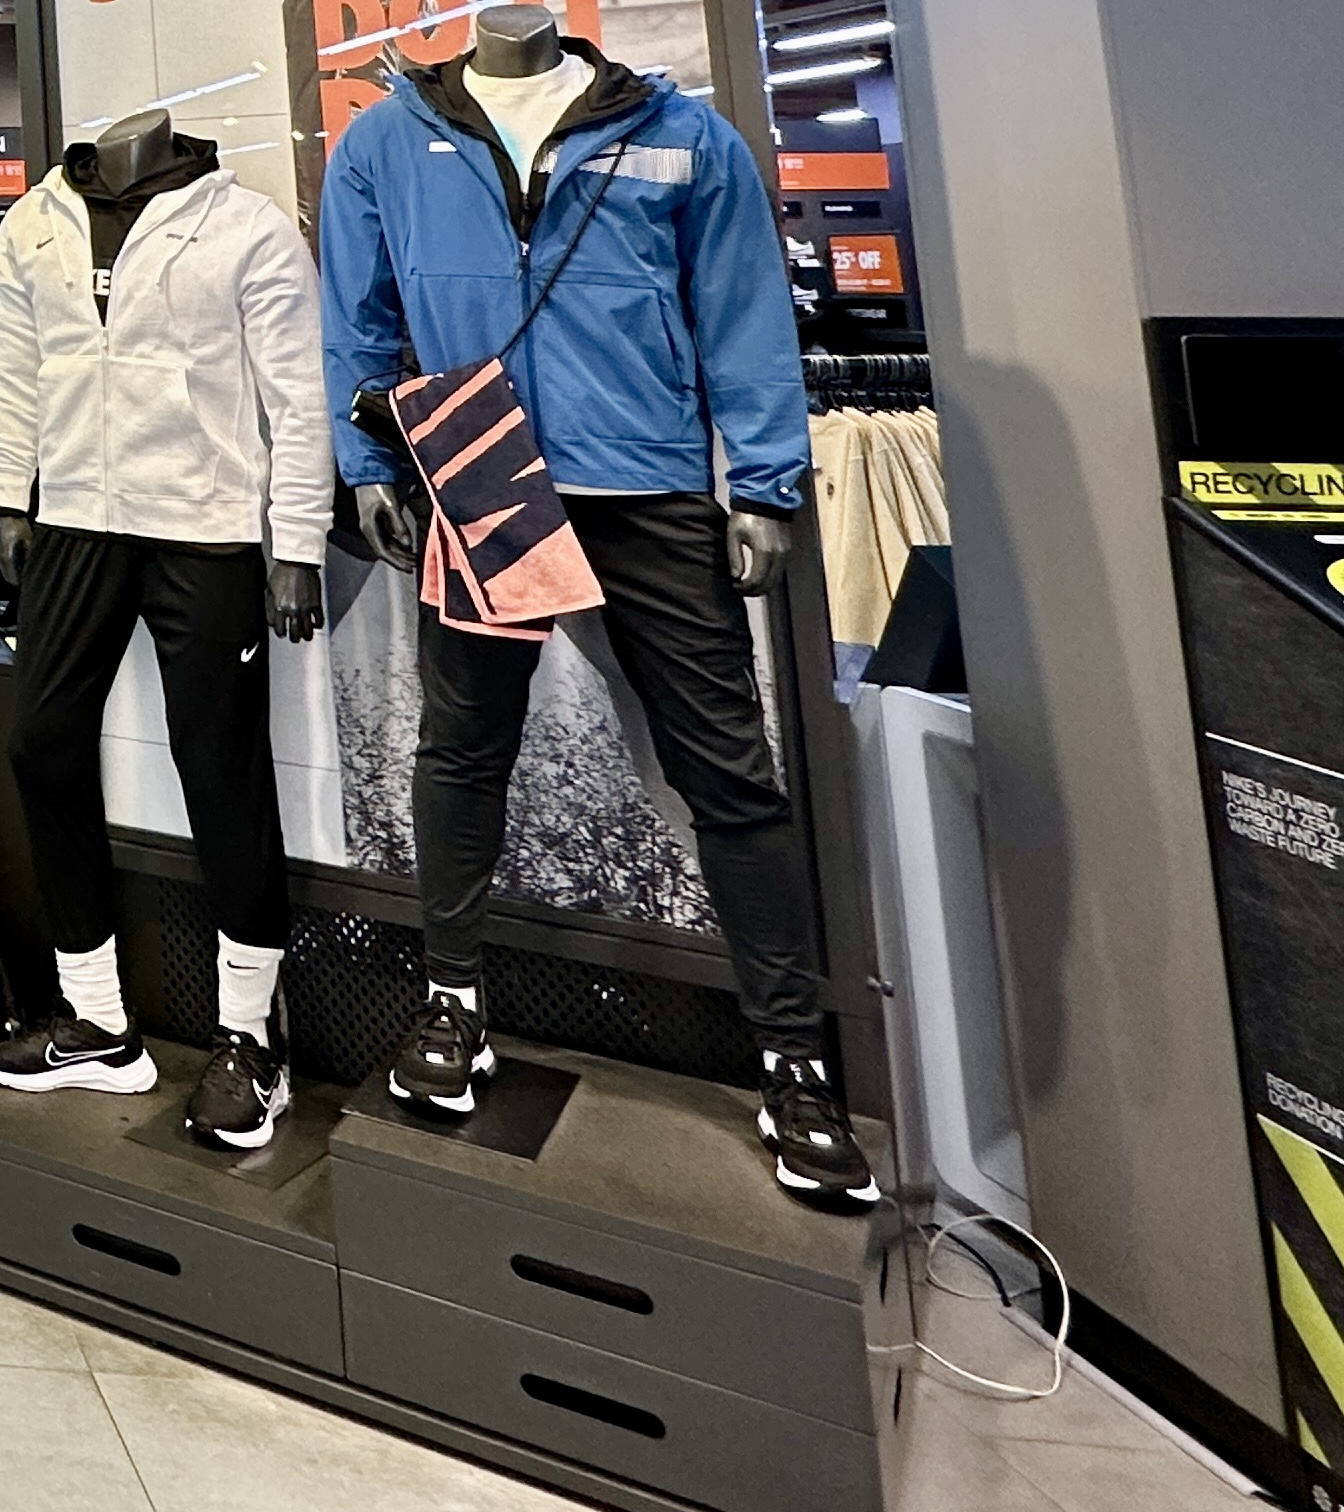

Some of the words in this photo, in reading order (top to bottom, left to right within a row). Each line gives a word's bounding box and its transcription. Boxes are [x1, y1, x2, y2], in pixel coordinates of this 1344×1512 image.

[858, 251, 881, 269] OFF
[1226, 816, 1277, 848] WASTE
[1277, 834, 1338, 870] FUTURE
[1288, 824, 1319, 846] AND
[1267, 1087, 1344, 1141] DONATION
